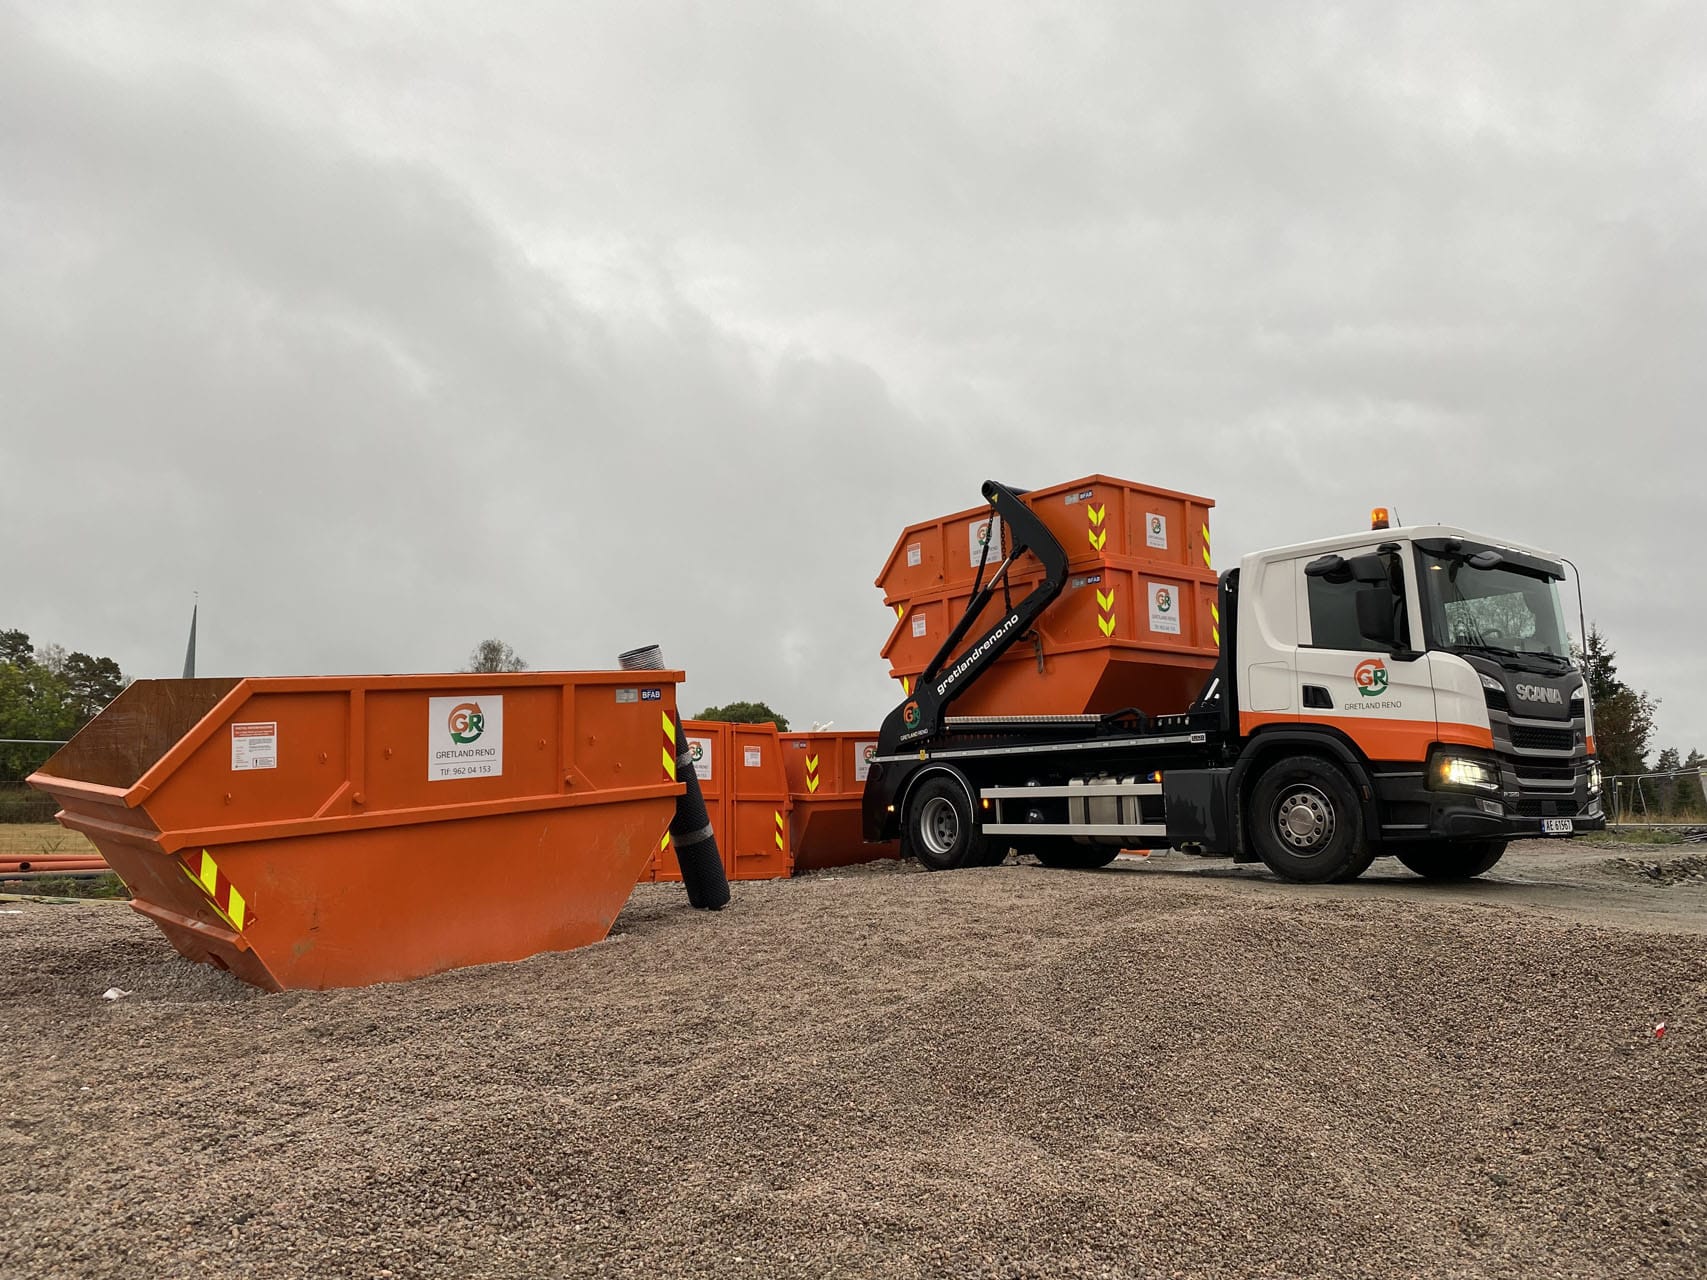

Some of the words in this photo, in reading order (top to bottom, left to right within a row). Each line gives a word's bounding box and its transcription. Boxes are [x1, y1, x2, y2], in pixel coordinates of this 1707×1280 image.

[937, 614, 1019, 695] gretlandreno.no
[1357, 669, 1389, 686] GR
[642, 690, 660, 699] BFAB
[1515, 683, 1563, 704] SCANIA
[1344, 702, 1380, 710] GRETLAND
[1381, 701, 1402, 709] RENO
[905, 709, 920, 722] GR
[451, 713, 484, 733] GR
[436, 749, 474, 759] GRETLAND
[475, 748, 496, 757] RENO
[452, 767, 466, 775] 962
[468, 766, 477, 774] 04
[479, 765, 492, 773] 153
[1546, 820, 1554, 831] AE
